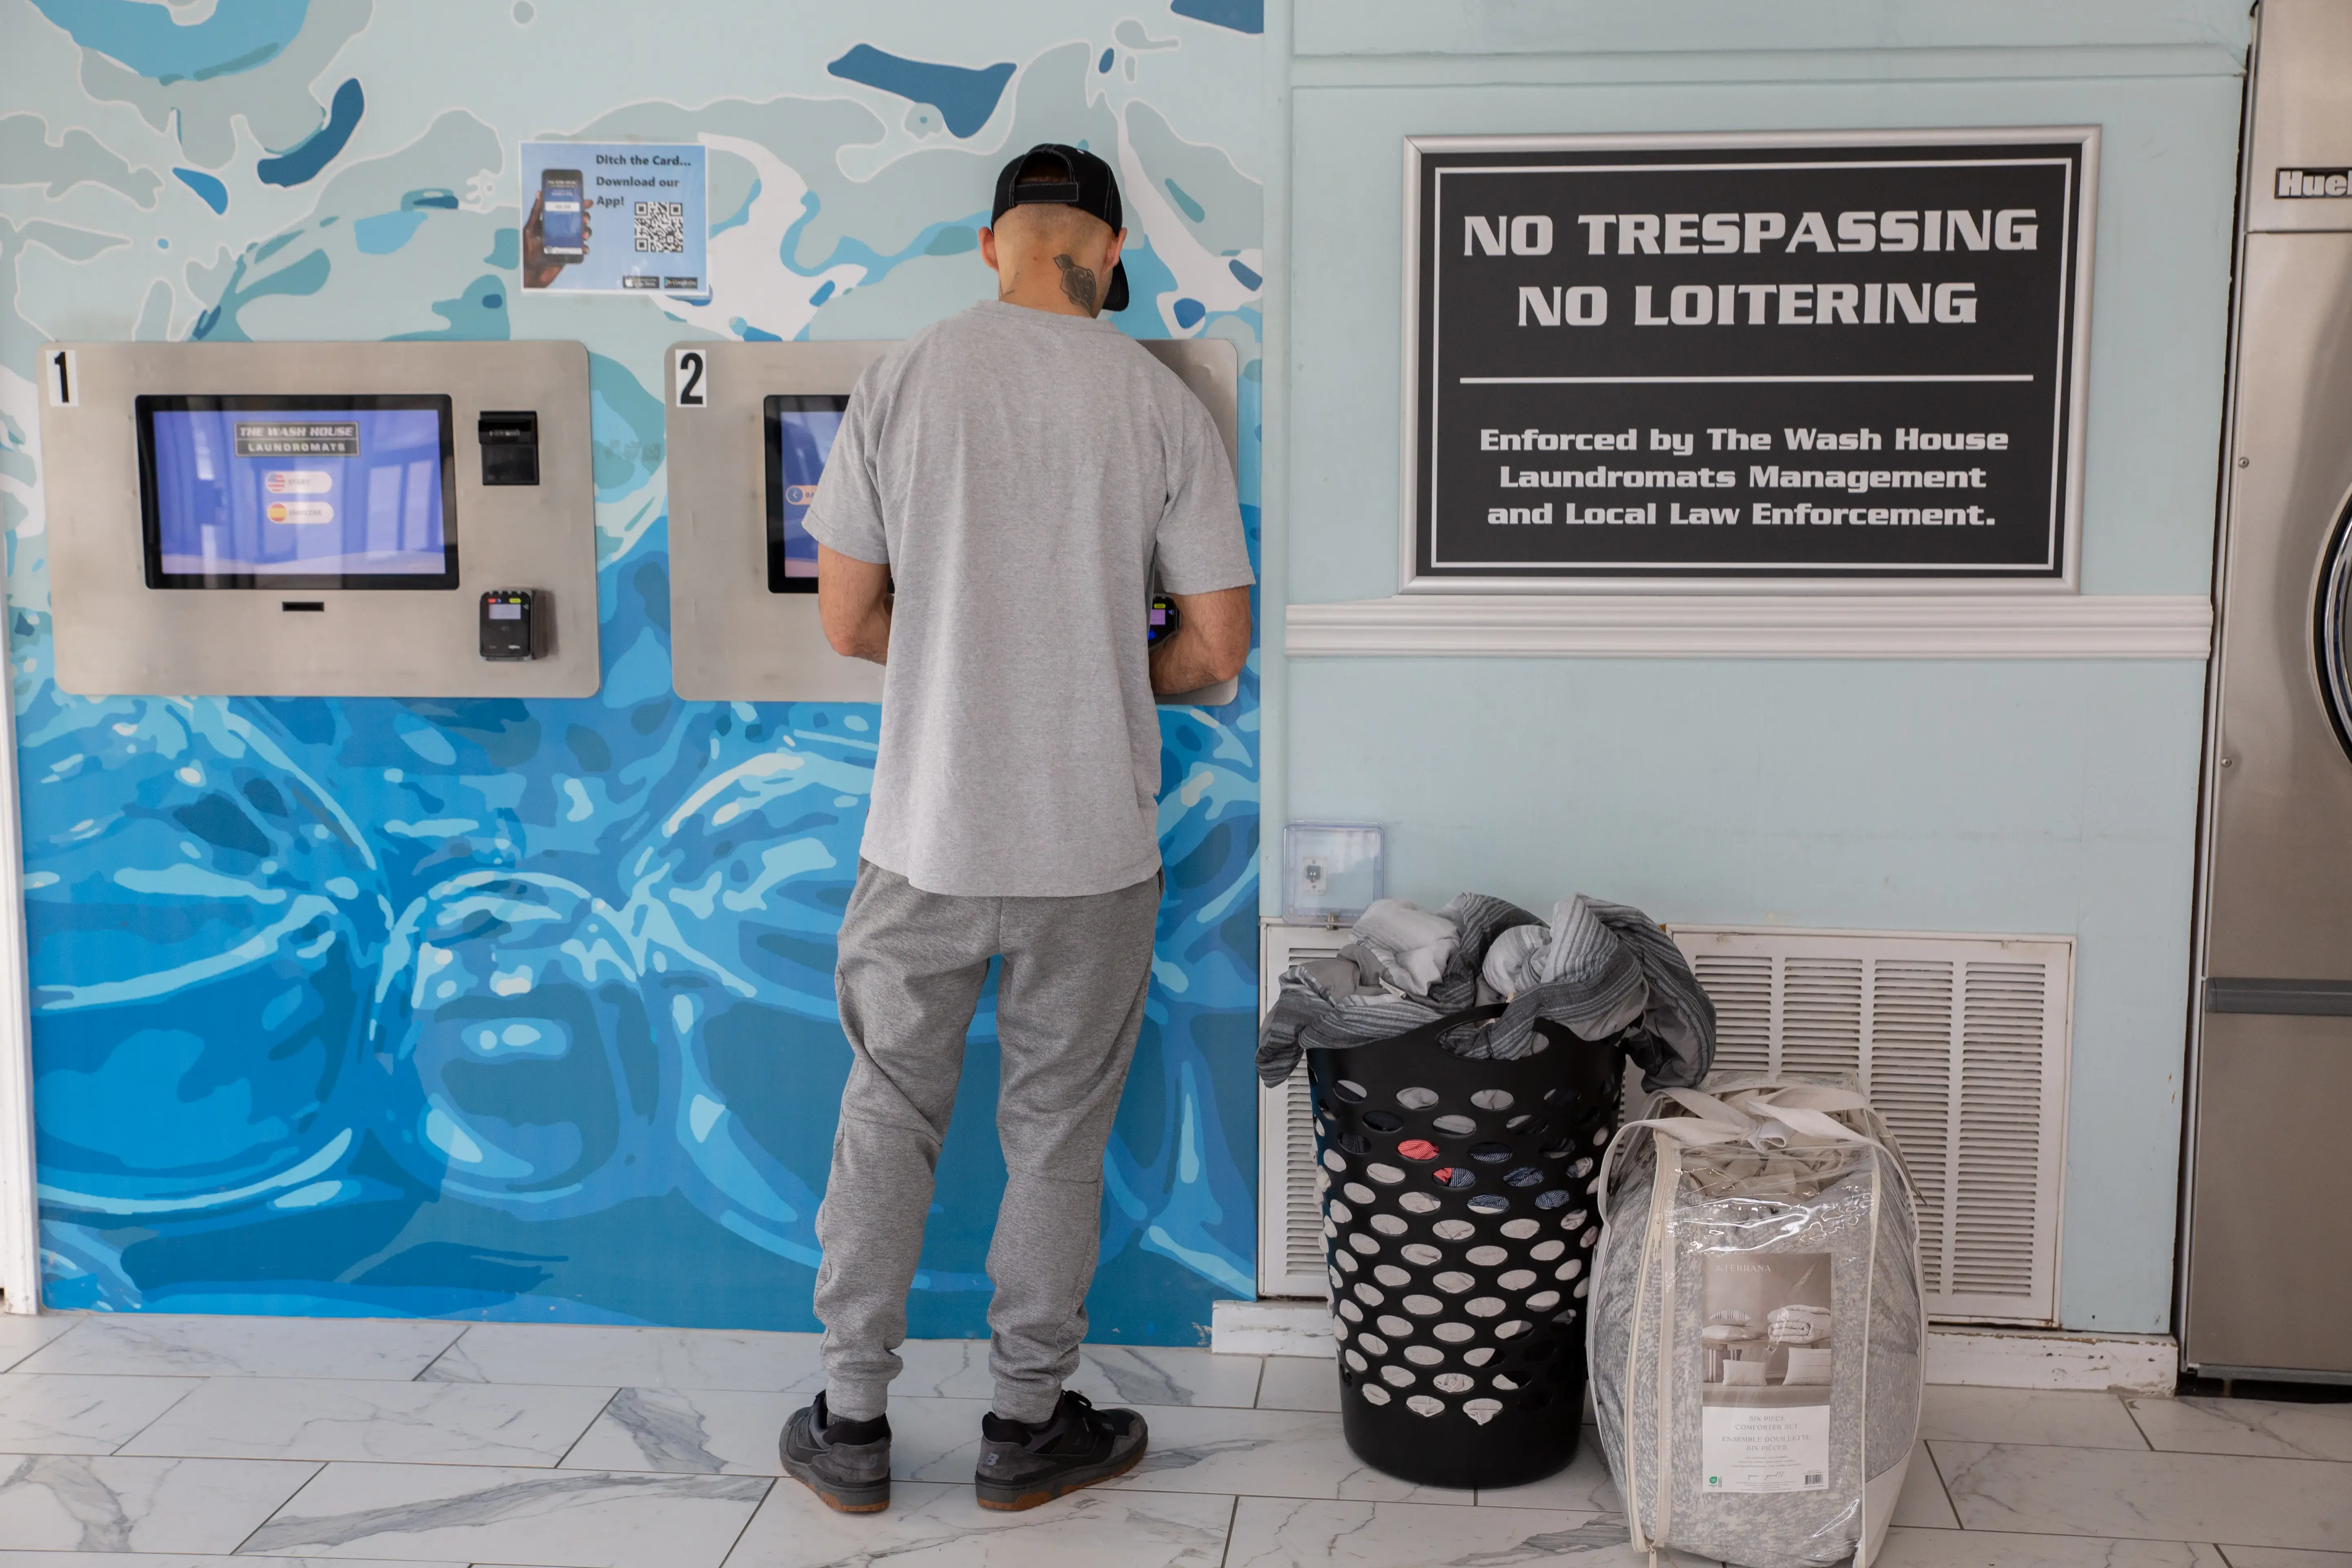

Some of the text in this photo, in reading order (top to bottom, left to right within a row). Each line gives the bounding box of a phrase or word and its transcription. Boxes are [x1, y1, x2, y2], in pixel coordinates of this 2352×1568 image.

[596, 155, 691, 166] Ditch the Card...
[597, 176, 655, 187] Download
[597, 196, 624, 208] App!
[1463, 209, 2038, 256] NO TRESPASSING
[1518, 282, 1978, 326] NO LOITERING
[54, 351, 69, 403] 1
[680, 352, 703, 404] 2
[239, 426, 354, 437] THE WASH HOUSE
[247, 442, 346, 452] LAUNDROMATS
[1480, 428, 2009, 456] Enforced by The Wash House
[1500, 465, 1987, 493] Laundromats Management
[1487, 502, 1996, 526] and Local Law Enforcement.
[1723, 1264, 1771, 1272] TERRANA
[1764, 1434, 1811, 1443] DOUILLETTE
